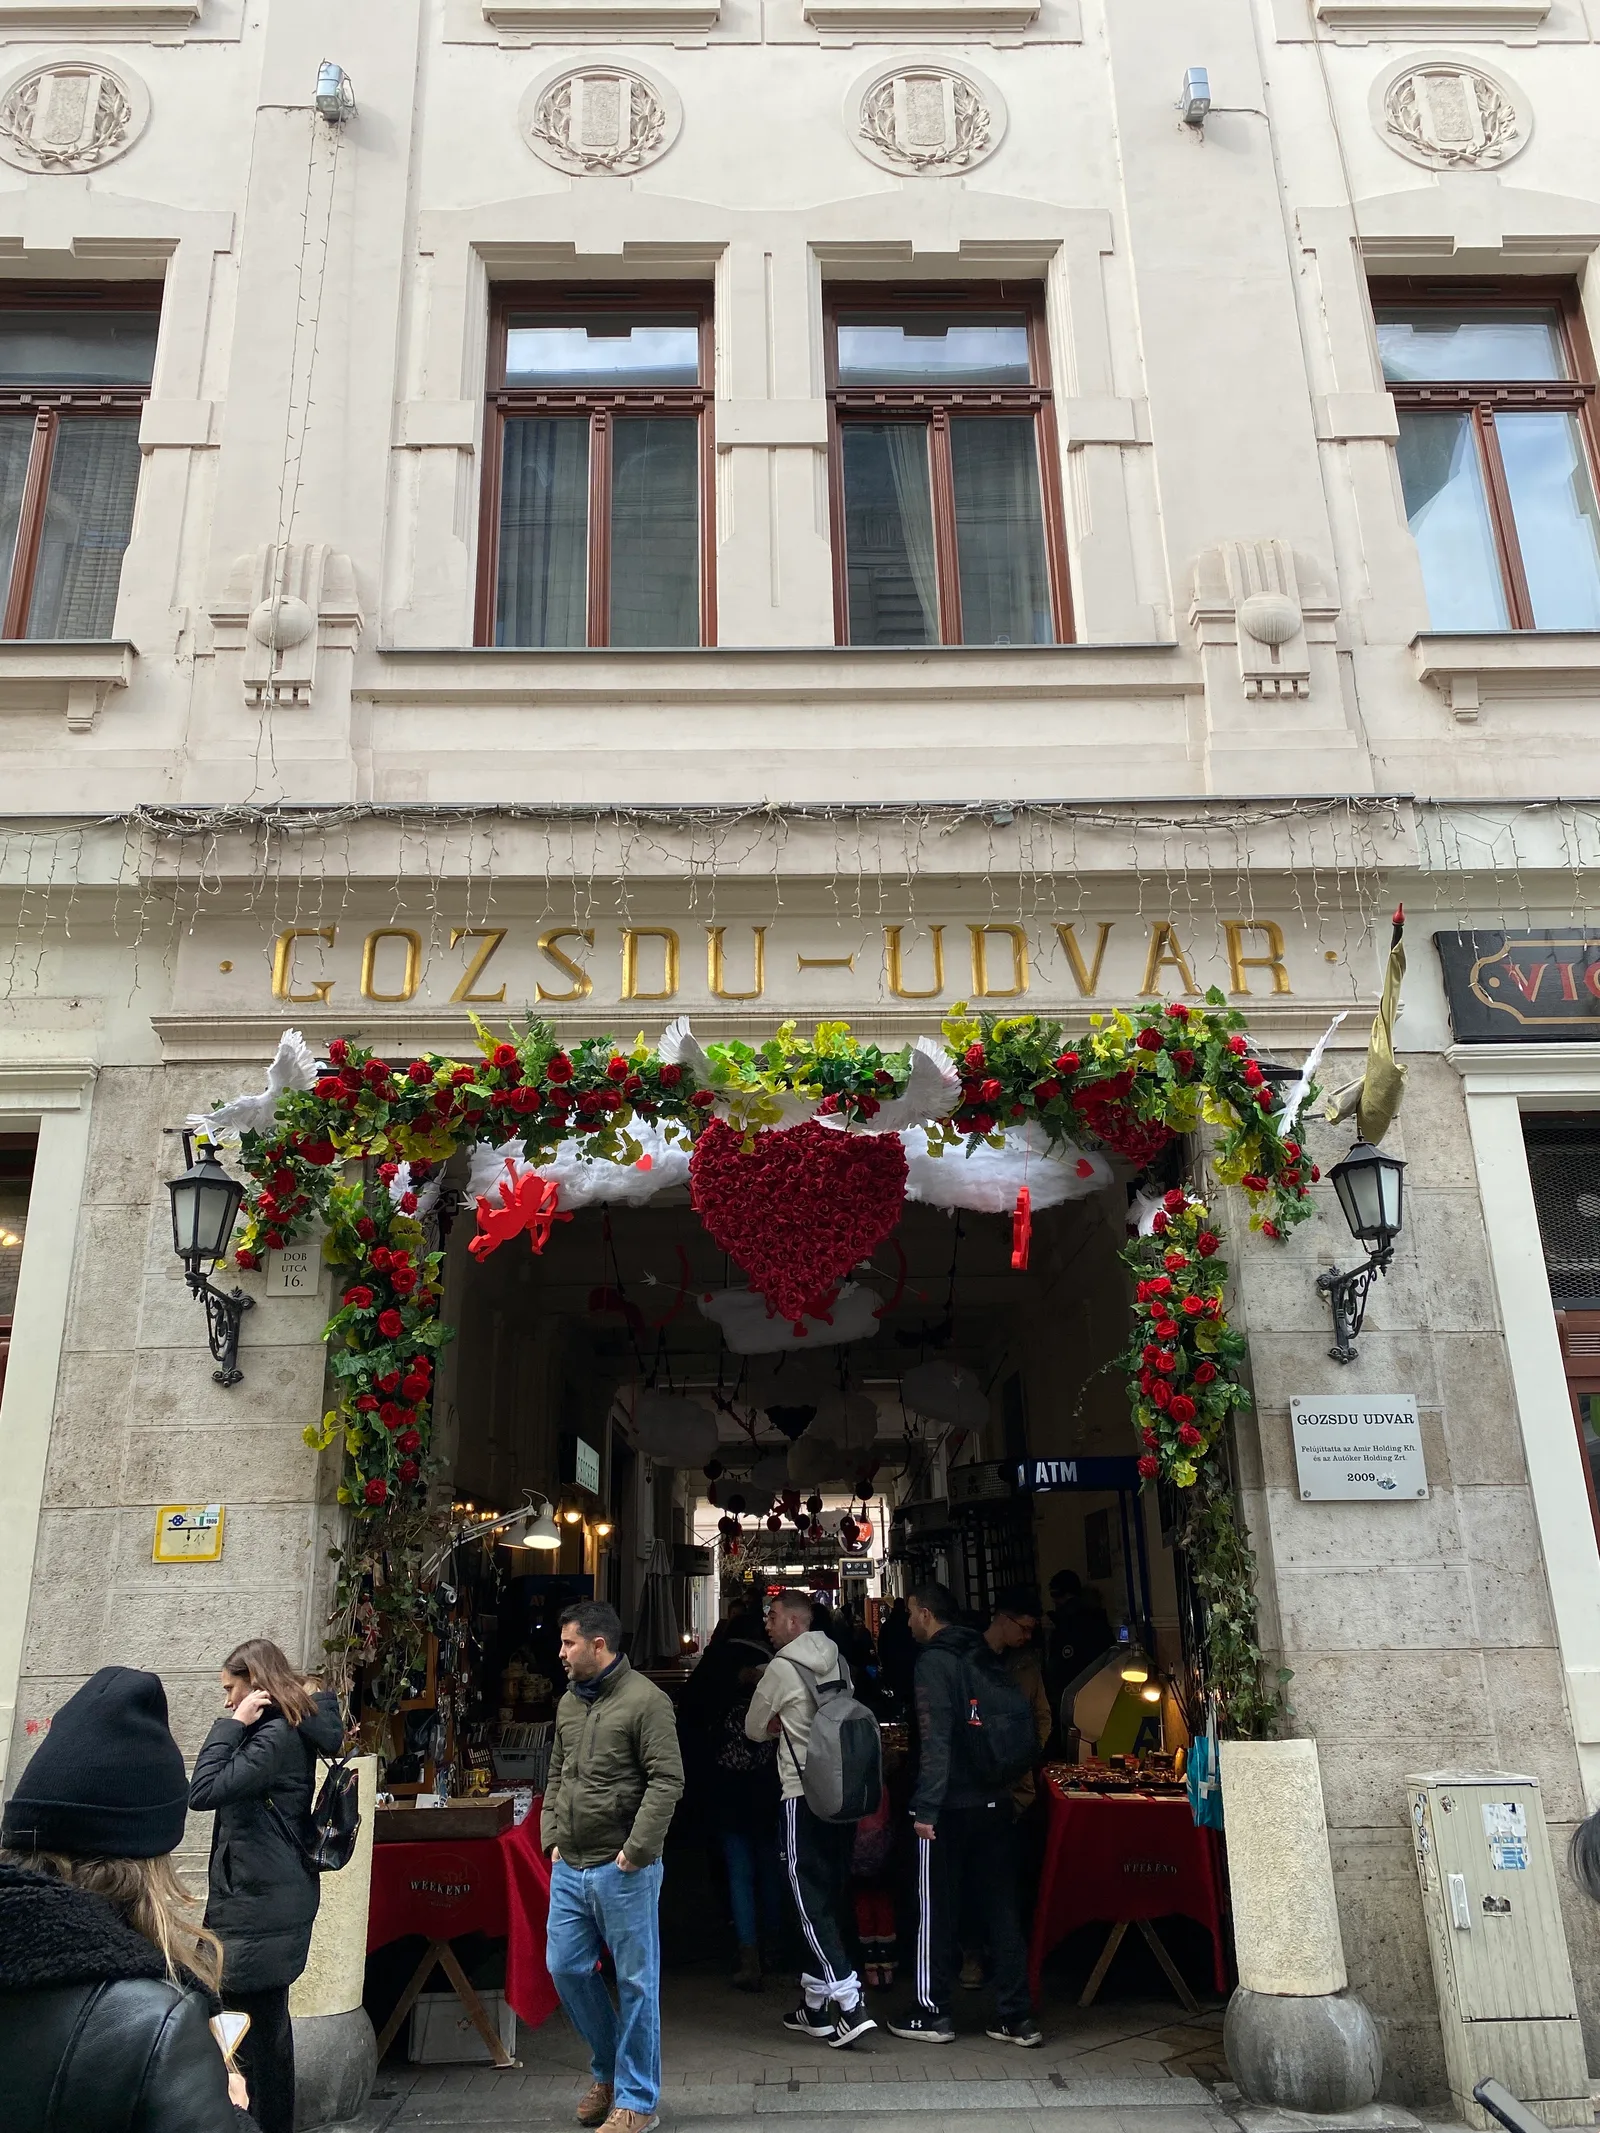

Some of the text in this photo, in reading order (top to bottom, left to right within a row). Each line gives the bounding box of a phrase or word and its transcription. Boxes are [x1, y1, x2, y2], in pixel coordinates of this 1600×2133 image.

[283, 1252, 308, 1261] DOB
[281, 1264, 308, 1272] UTCA
[283, 1274, 304, 1288] 16.
[1296, 1412, 1415, 1426] GOZSDU UDVAR
[1373, 1444, 1402, 1453] Holding
[1313, 1454, 1322, 1462] és
[1363, 1454, 1393, 1463] Holding
[1035, 1461, 1078, 1483] ATM
[1347, 1472, 1380, 1482] 2009.
[410, 1880, 471, 1896] WEEKEND
